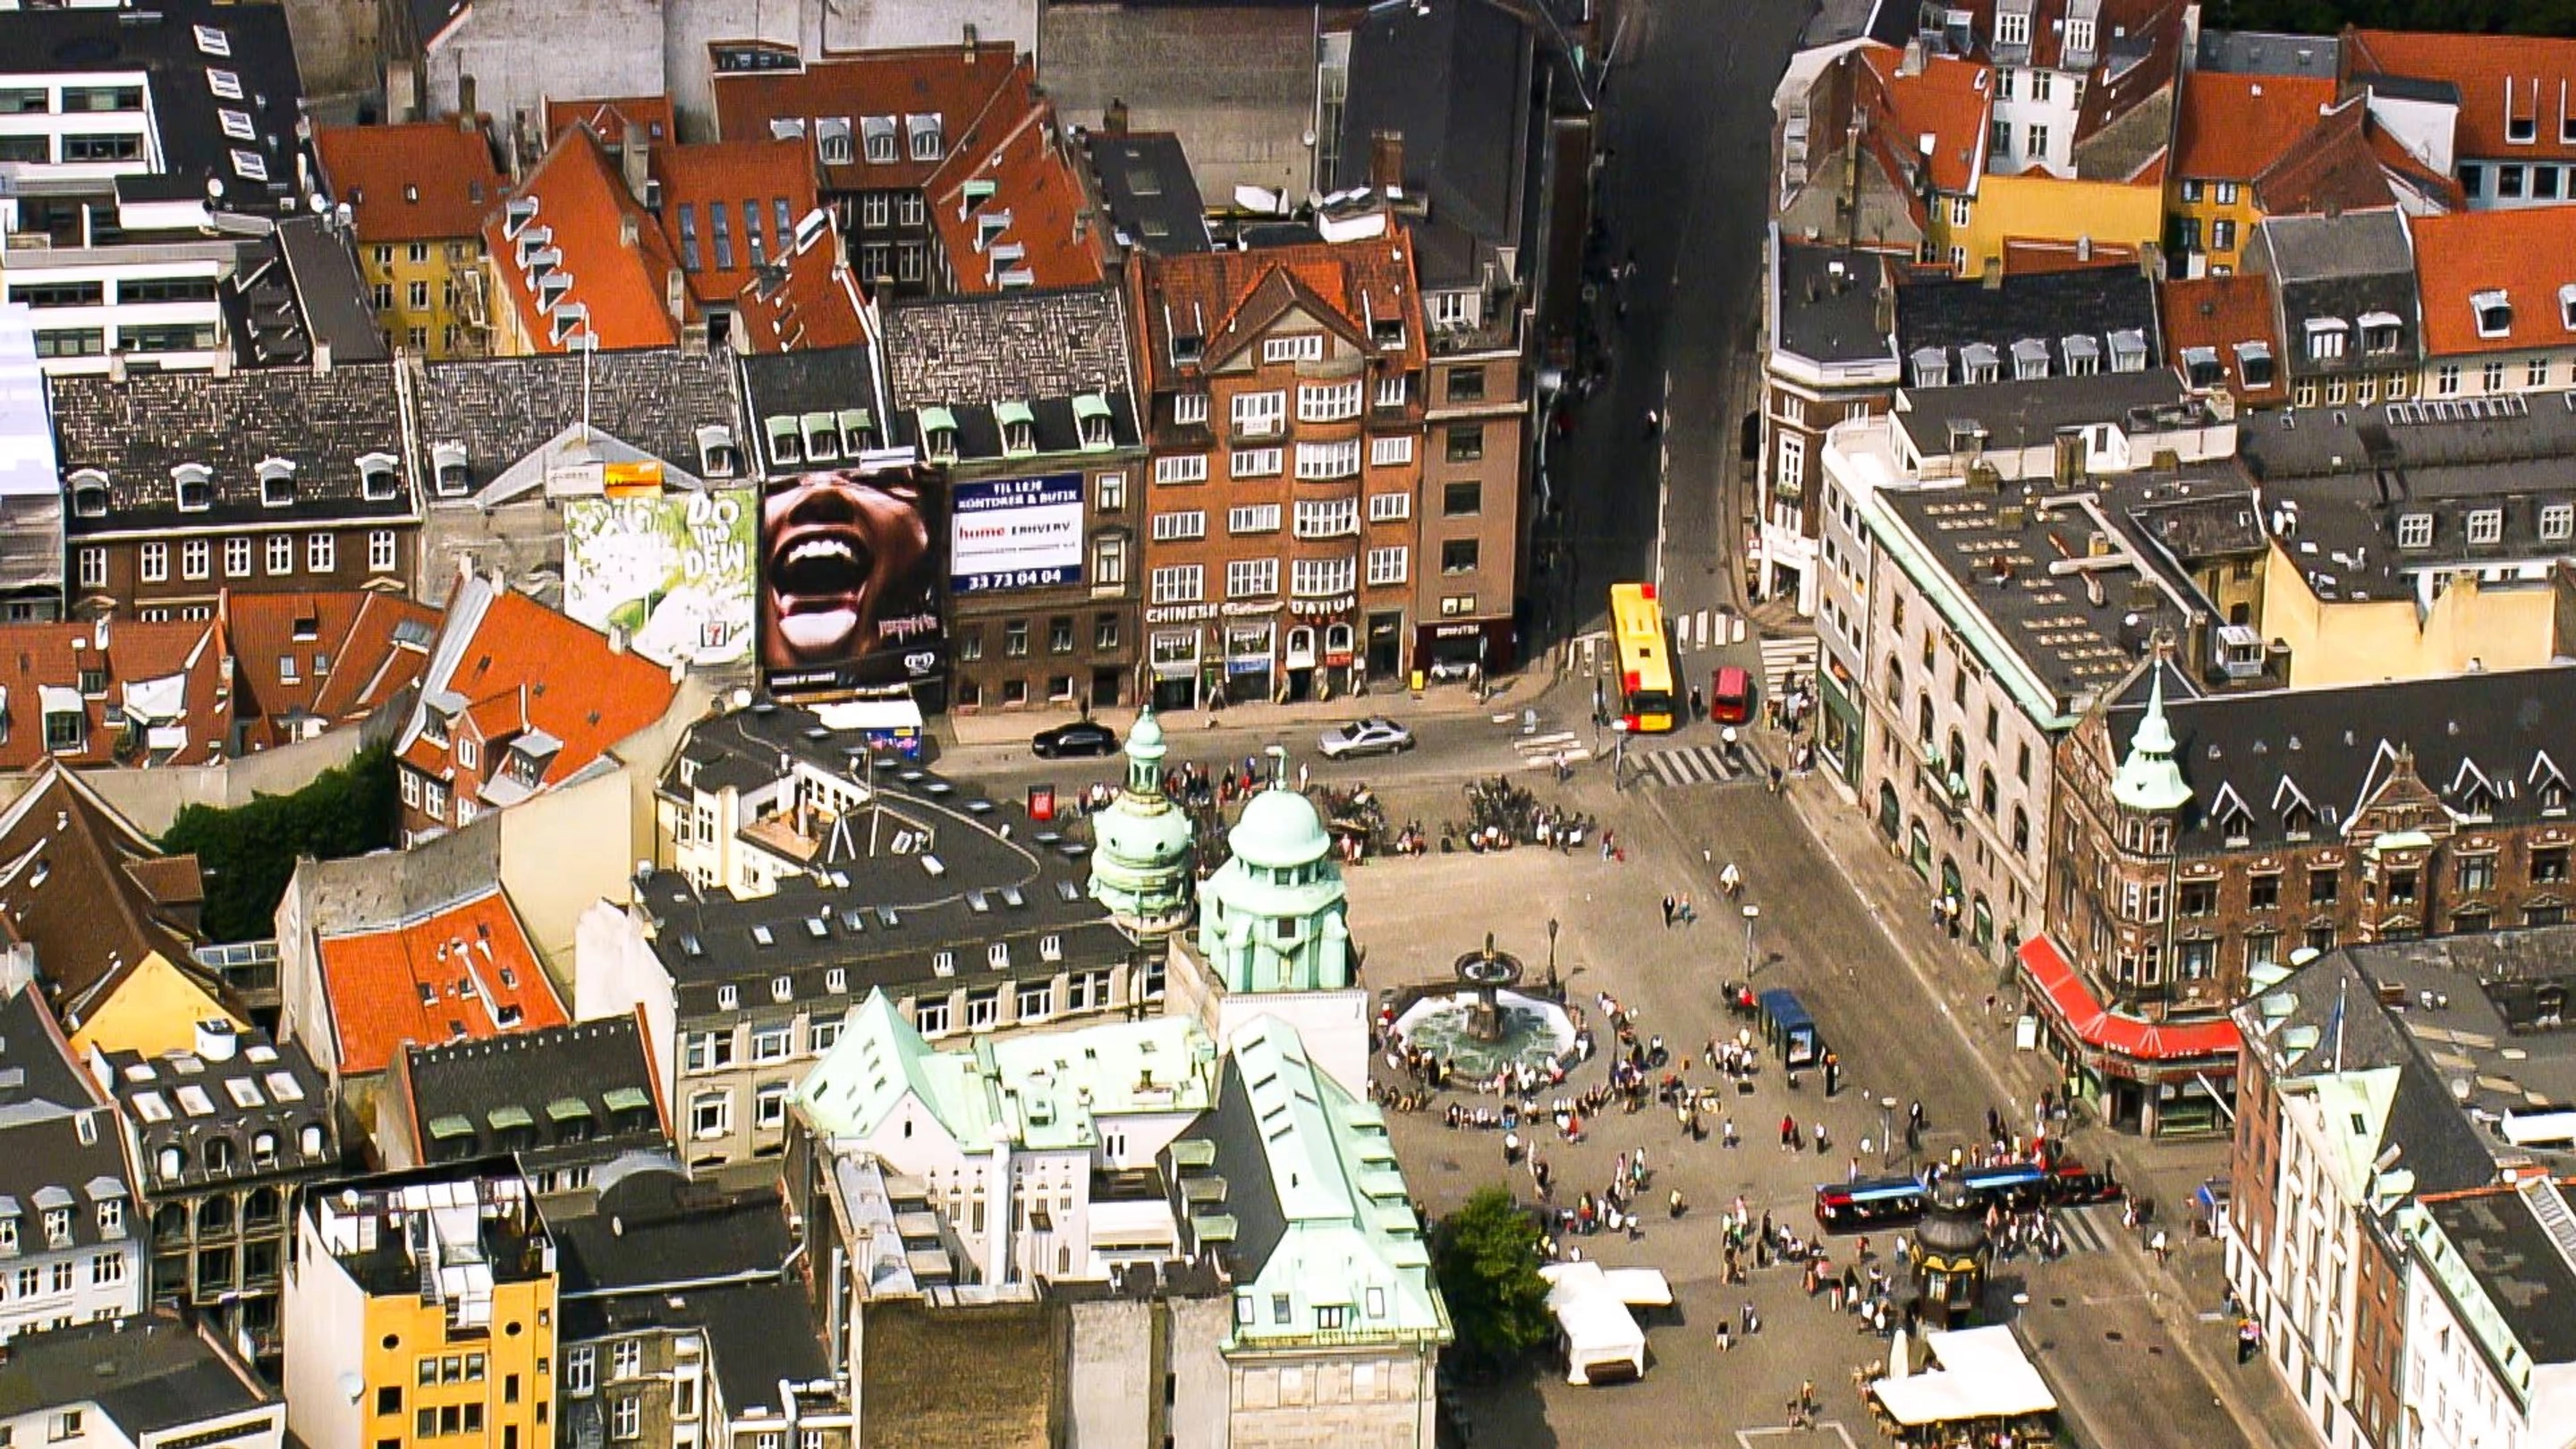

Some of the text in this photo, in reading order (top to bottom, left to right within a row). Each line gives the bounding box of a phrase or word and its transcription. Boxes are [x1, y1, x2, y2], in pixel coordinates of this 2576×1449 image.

[687, 491, 741, 526] DO
[684, 542, 746, 581] DEW
[994, 572, 1013, 588] 73
[1017, 571, 1038, 586] 04
[1041, 569, 1062, 584] 04
